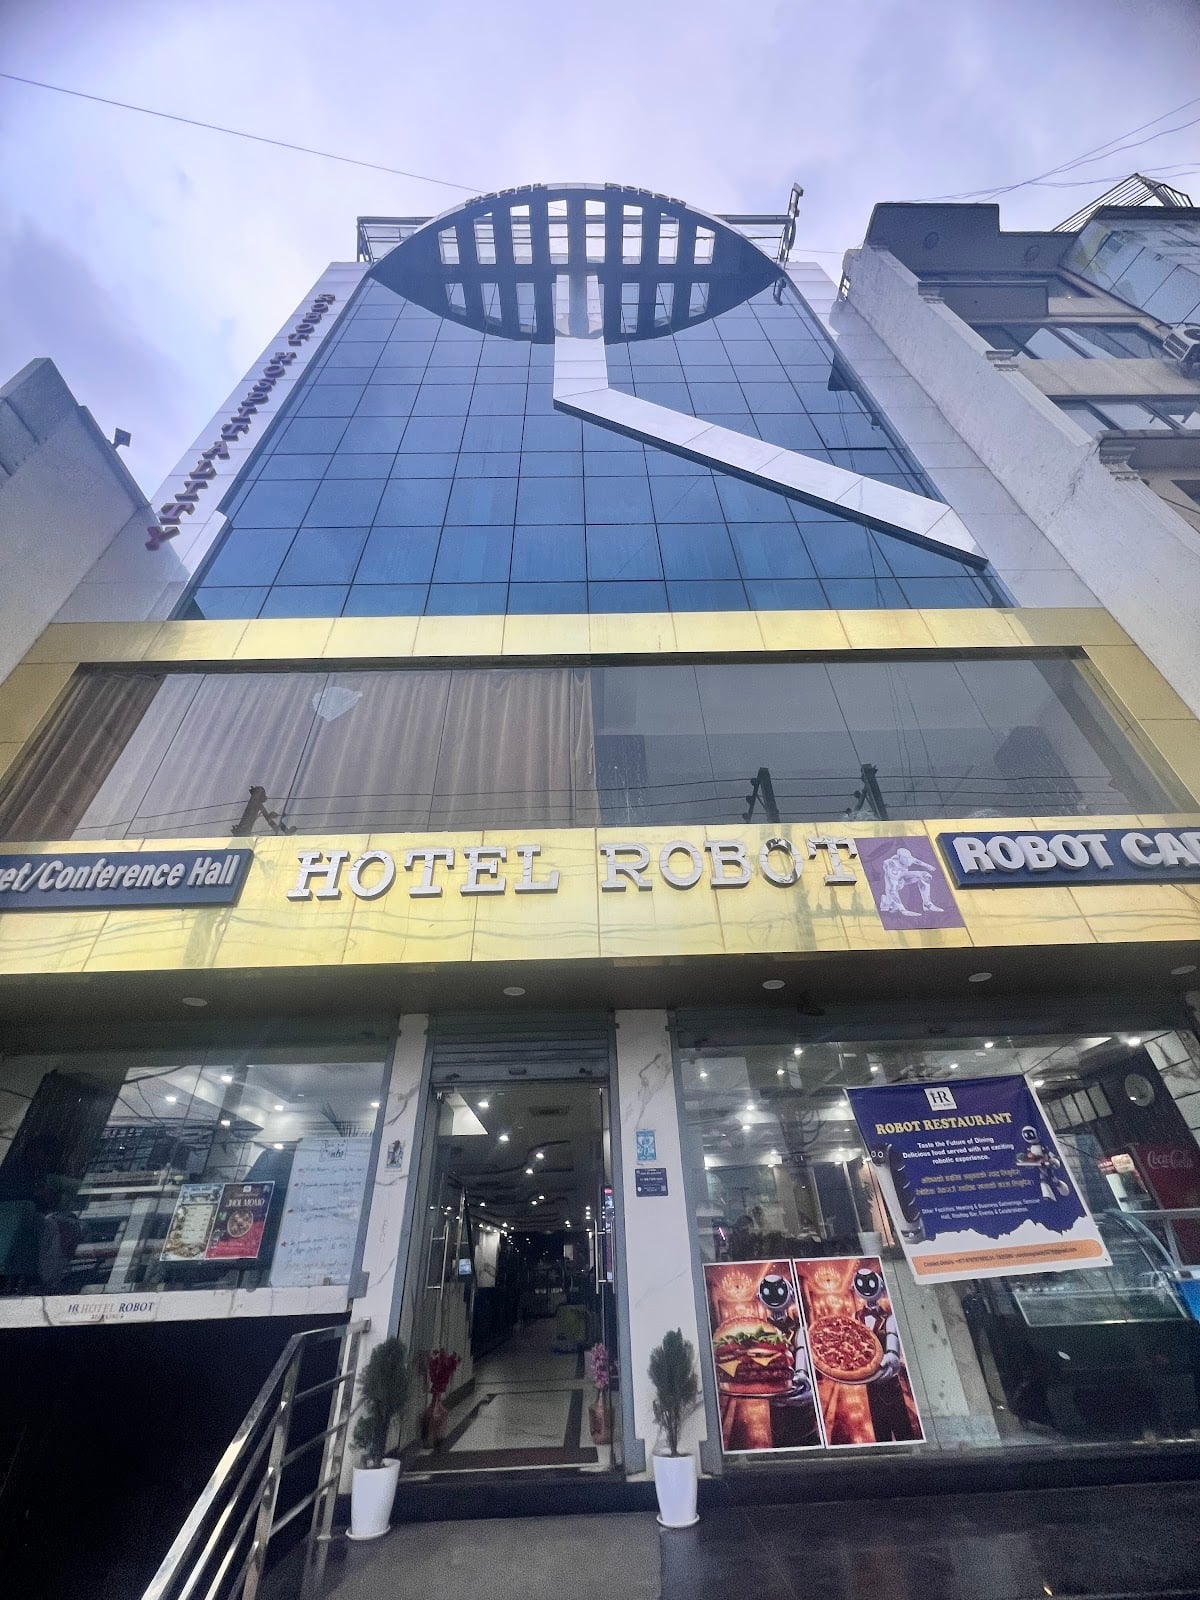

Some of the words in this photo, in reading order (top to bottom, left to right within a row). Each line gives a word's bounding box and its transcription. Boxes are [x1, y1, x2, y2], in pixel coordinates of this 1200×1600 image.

[952, 833, 1114, 873] ROBOT
[0, 858, 186, 893] et/Conference
[187, 855, 240, 887] Hall
[287, 844, 560, 900] HOTEL
[600, 837, 858, 892] ROBOT
[875, 1120, 921, 1135] ROBOT
[922, 1112, 1012, 1131] RESTAURANT
[932, 1148, 946, 1156] food
[947, 1147, 967, 1155] served
[968, 1145, 981, 1153] with
[119, 1302, 154, 1313] ROBOT
